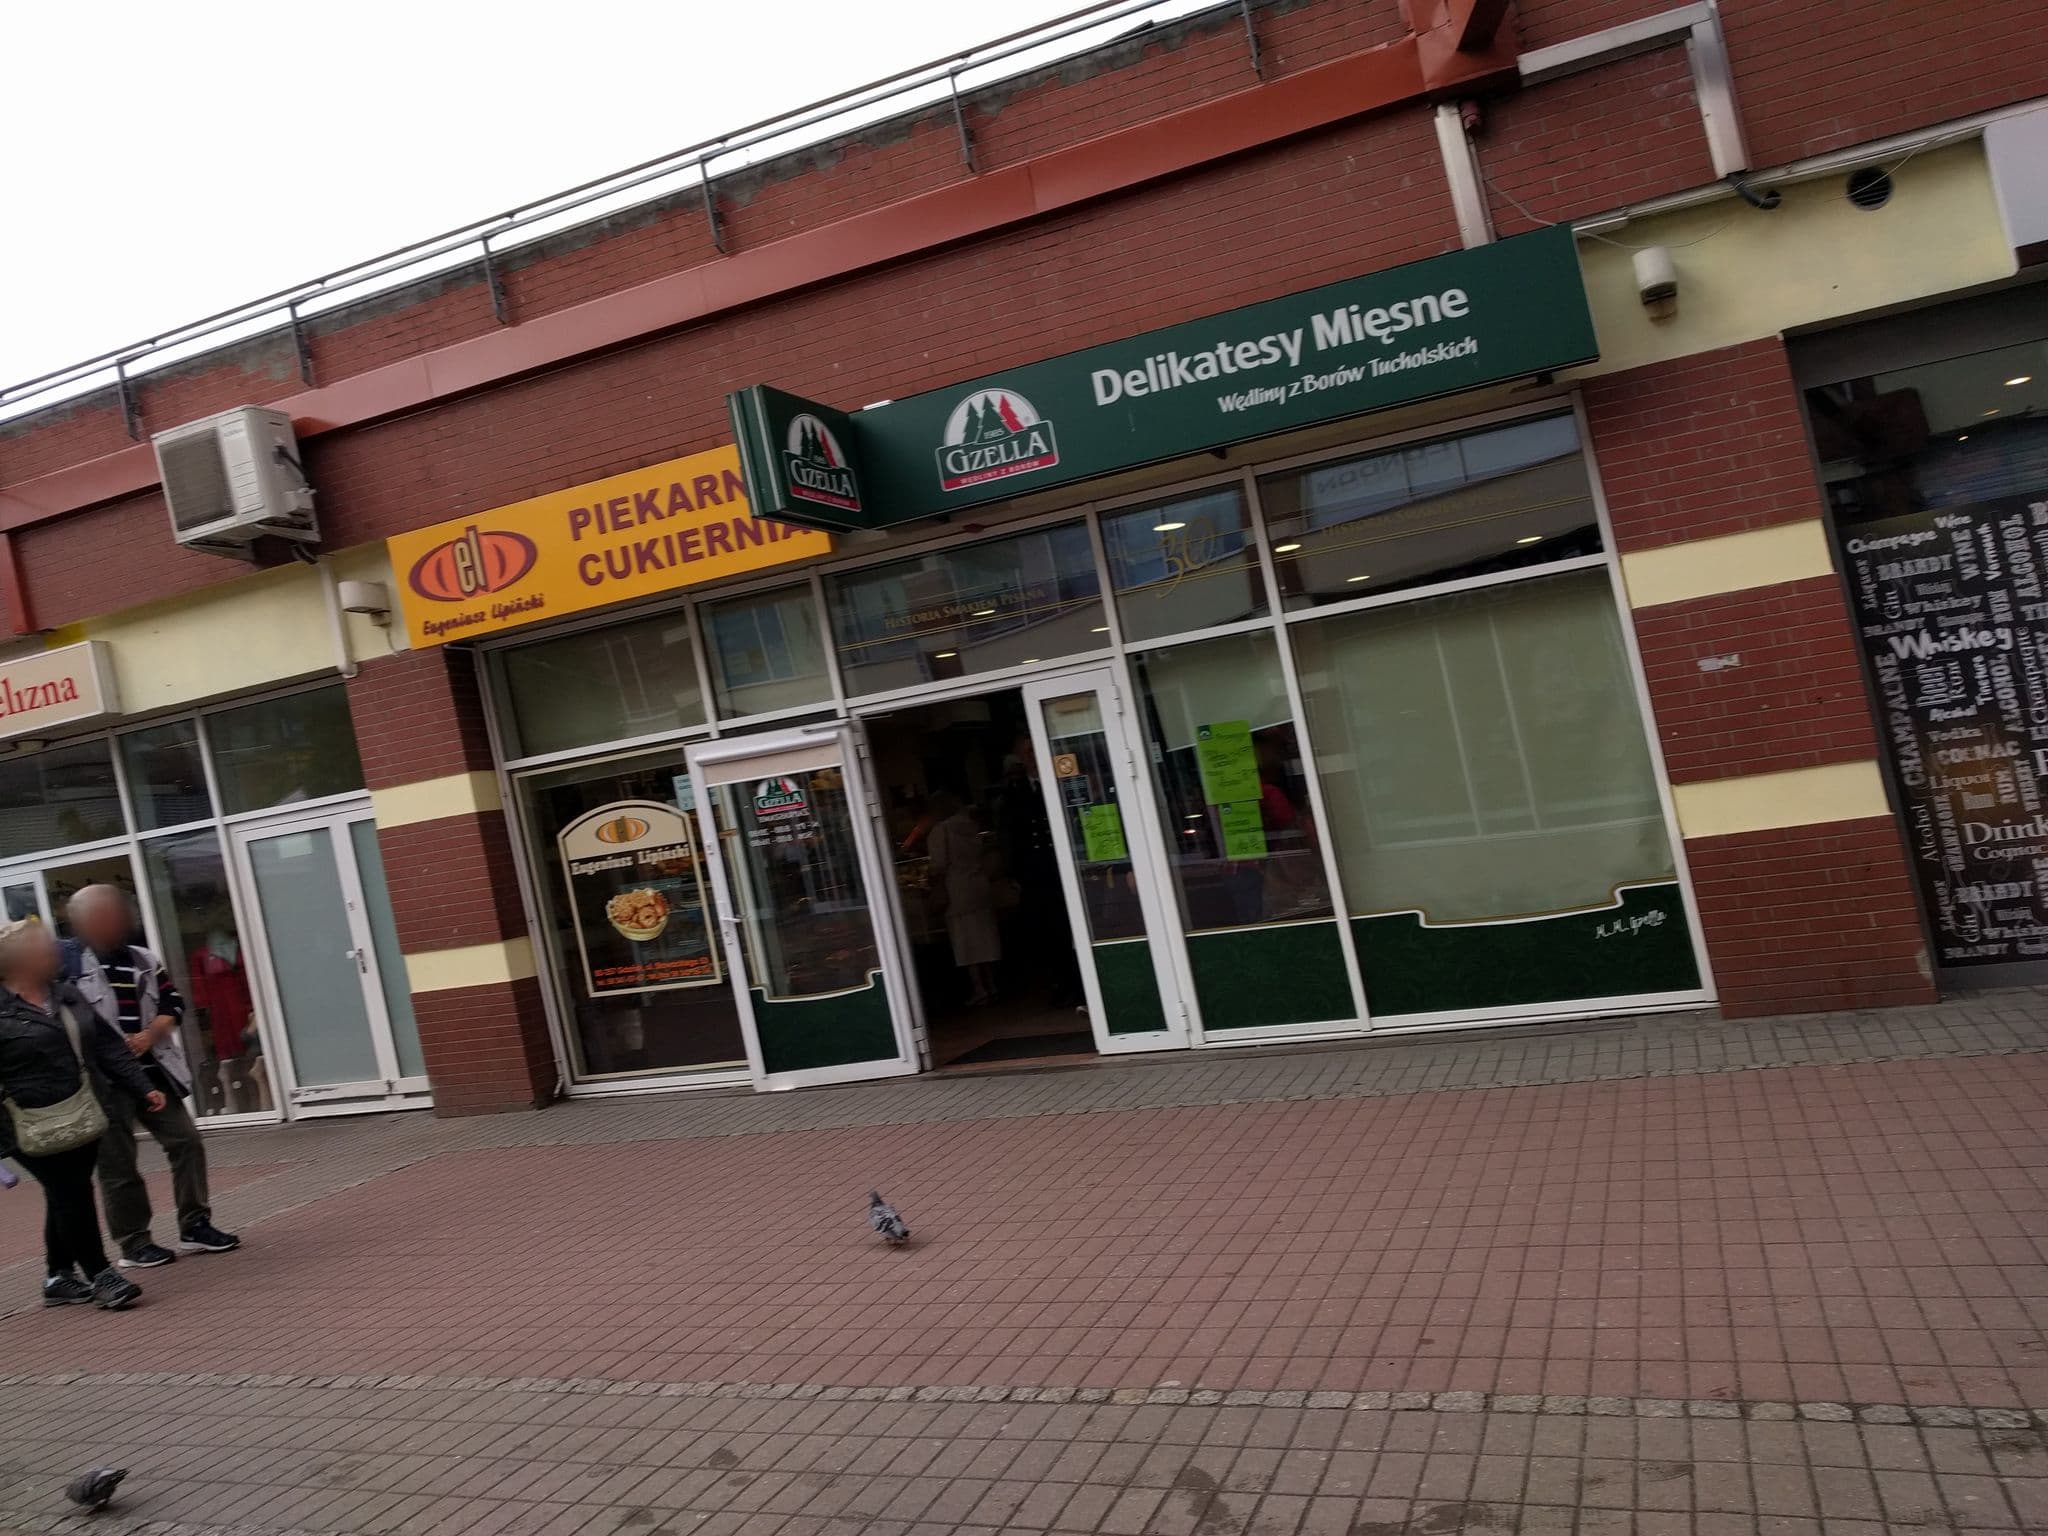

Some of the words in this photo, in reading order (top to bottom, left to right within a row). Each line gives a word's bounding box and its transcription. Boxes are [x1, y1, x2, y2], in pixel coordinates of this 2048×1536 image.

[1091, 328, 1303, 406] Delikatesy
[1311, 288, 1470, 351] Mięsne
[1217, 386, 1286, 413] Wędliny
[1301, 364, 1366, 393] Borów
[1368, 335, 1478, 377] Tucholskich
[568, 469, 748, 541] PIEKARN
[1951, 529, 1981, 581] WINE
[1999, 512, 2042, 598] ALCOHOL
[1888, 626, 2013, 661] Whiskey
[0, 678, 79, 719] lizna
[1909, 803, 1941, 863] Alcohol
